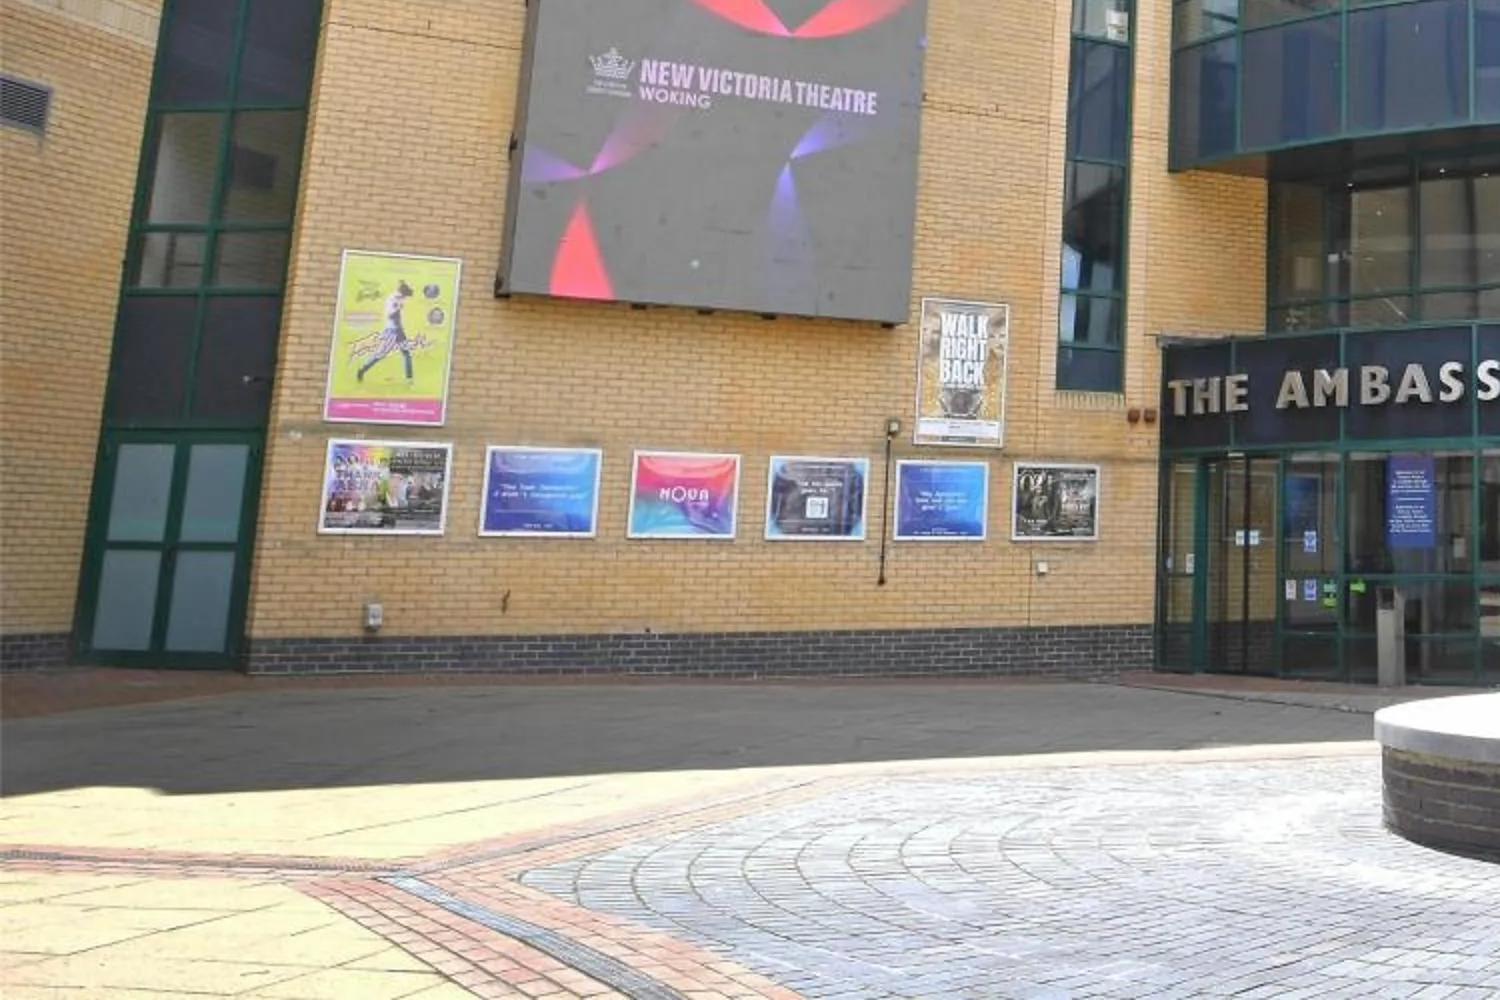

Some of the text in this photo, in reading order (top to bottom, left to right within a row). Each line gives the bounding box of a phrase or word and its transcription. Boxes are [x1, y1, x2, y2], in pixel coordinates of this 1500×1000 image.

[639, 86, 712, 110] WOKING
[640, 59, 696, 90] NEW
[698, 67, 793, 105] VICTORIA
[794, 81, 878, 115] THEATRE
[941, 313, 989, 339] WALK
[940, 337, 987, 361] RIGHT
[940, 360, 985, 386] BACK
[1167, 373, 1250, 418] THE
